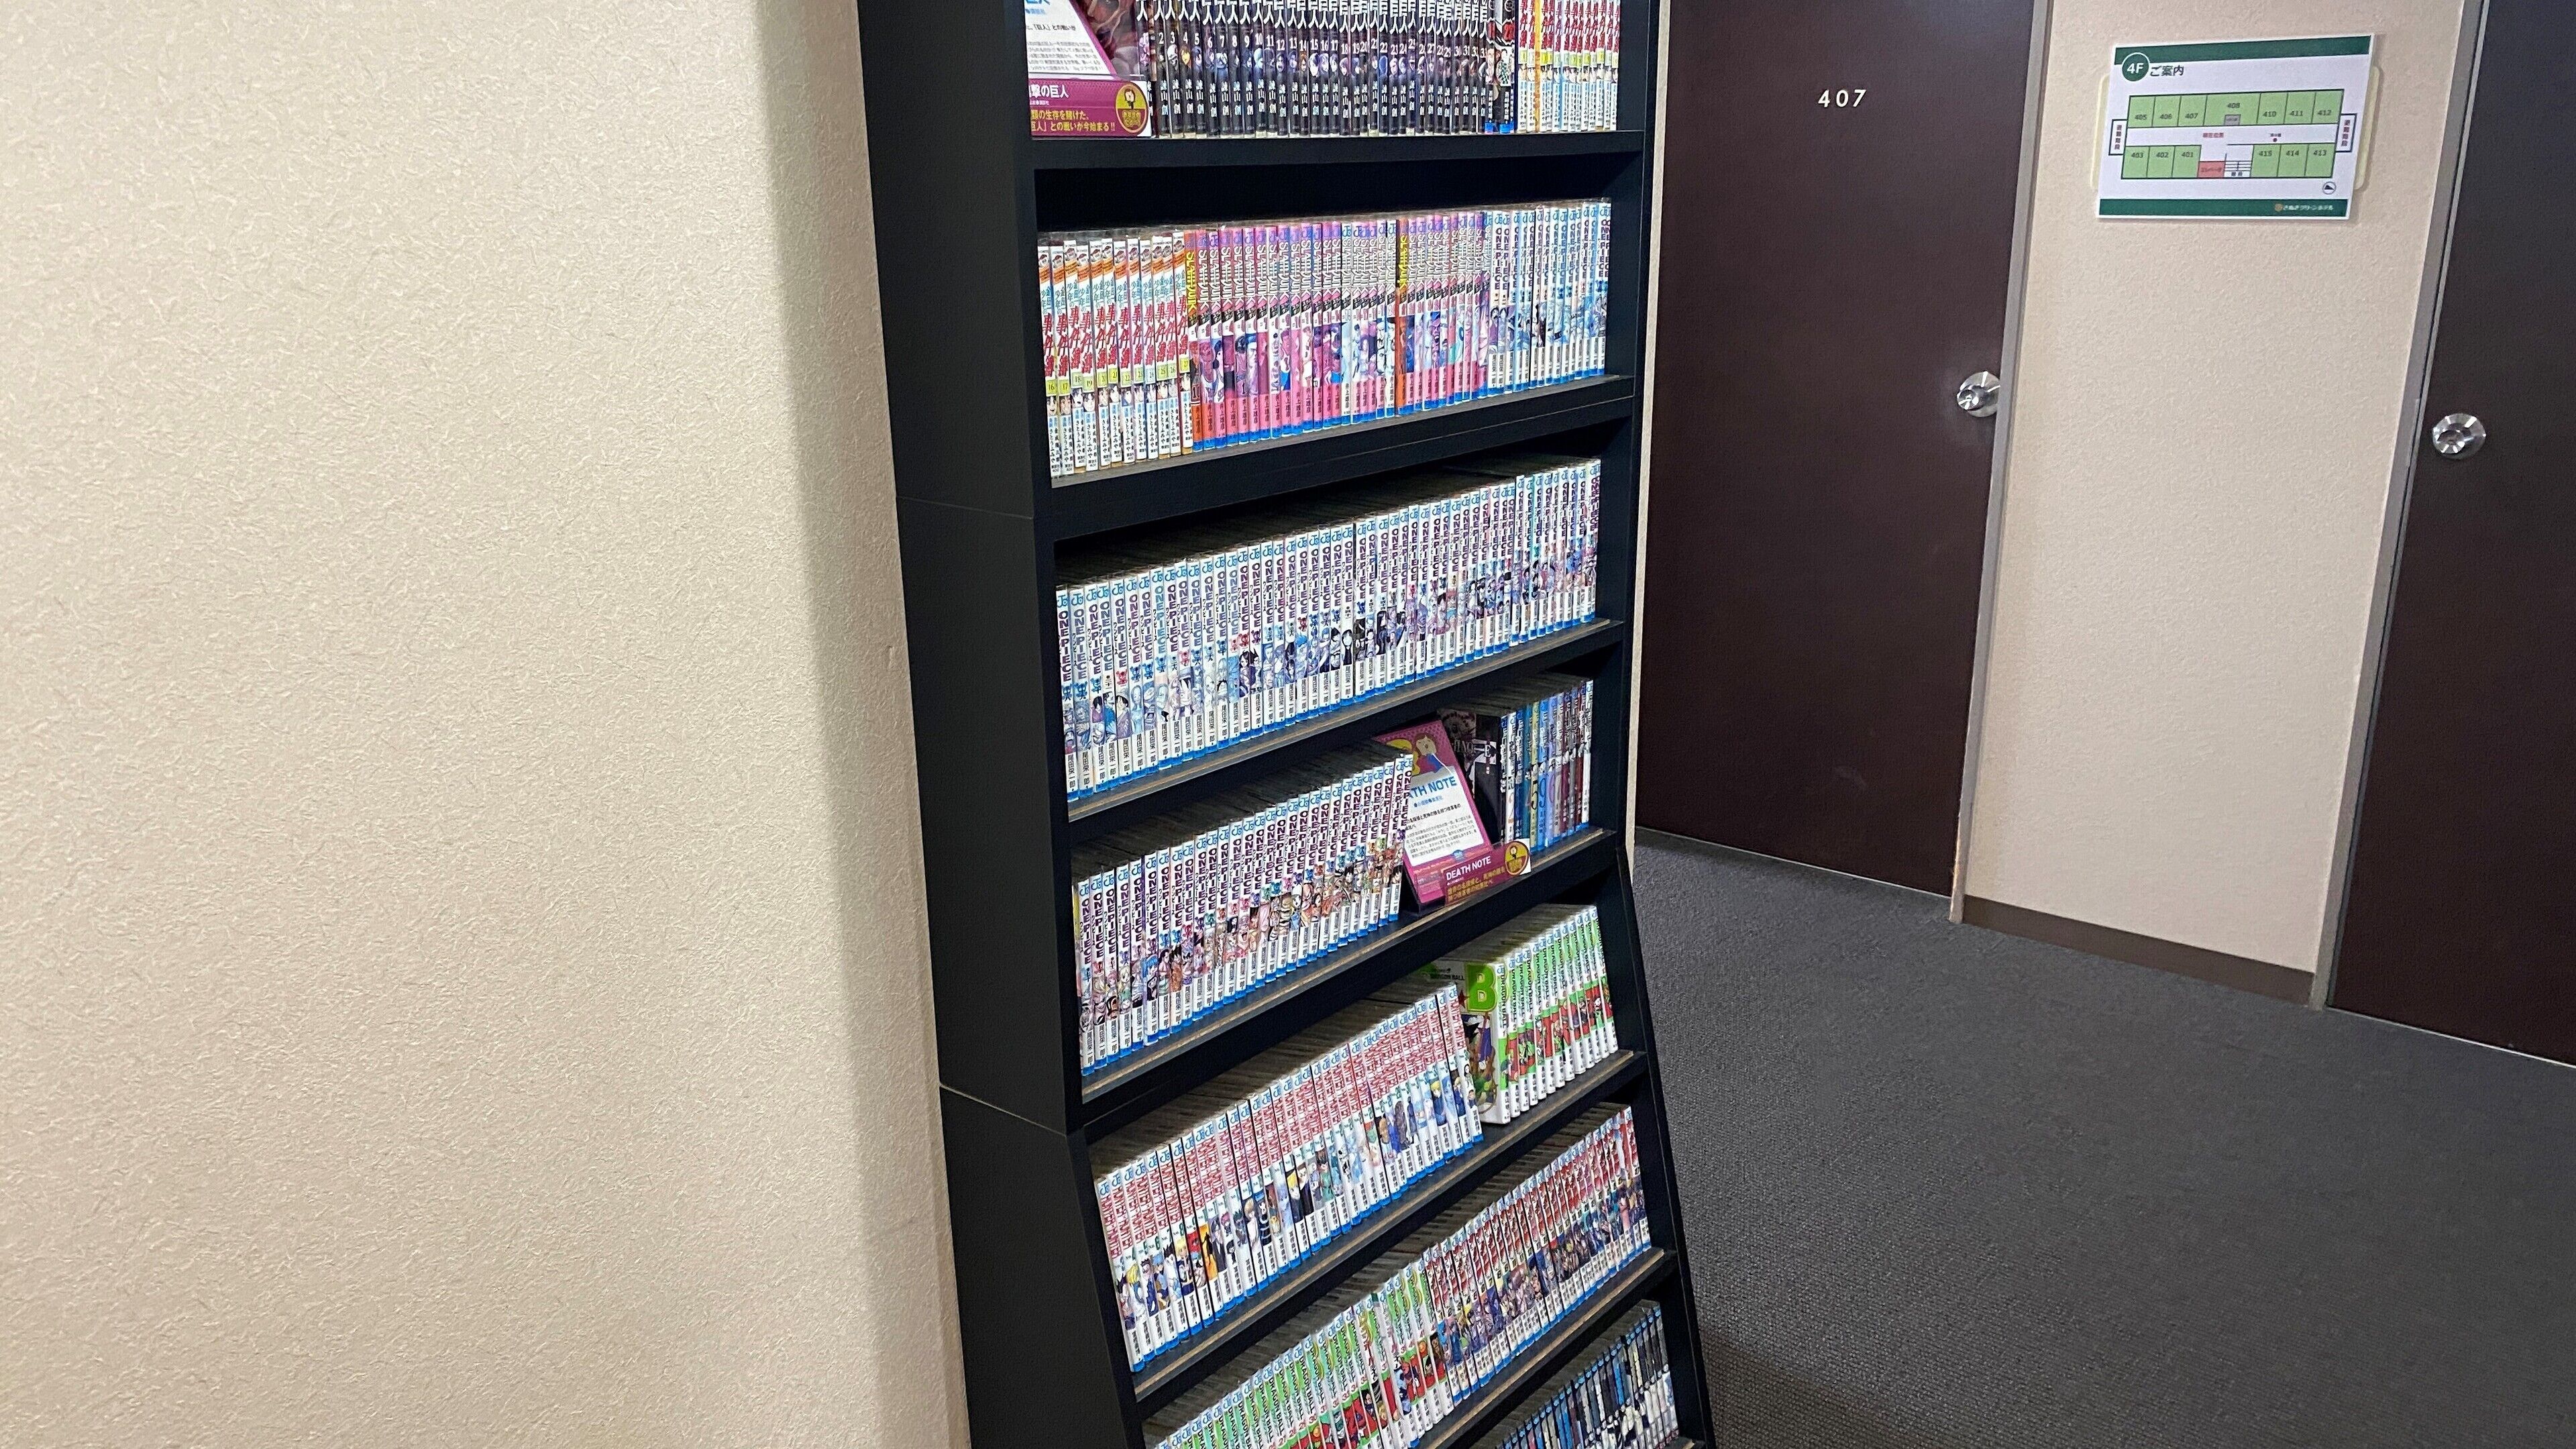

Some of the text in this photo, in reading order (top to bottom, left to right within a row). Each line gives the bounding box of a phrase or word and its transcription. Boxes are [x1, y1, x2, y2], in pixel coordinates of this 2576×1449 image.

[1159, 32, 1164, 44] 2
[1170, 32, 1175, 44] 3
[1183, 32, 1188, 44] 4
[1194, 33, 1199, 45] 5
[1208, 37, 1213, 48] 6
[1220, 36, 1225, 48] 7
[1232, 35, 1238, 48] 8
[1244, 36, 1250, 48] 9
[1254, 33, 1263, 45] 10
[1267, 34, 1274, 47] 11
[1276, 39, 1285, 51] 12
[1289, 37, 1297, 49] 13
[1299, 40, 1307, 51] 14
[1310, 38, 1318, 50] 15
[1320, 40, 1328, 51] 16
[1330, 40, 1338, 51] 17
[1341, 43, 1348, 55] 18
[2127, 62, 2144, 74] 4F
[2149, 64, 2184, 76] ご案内
[1028, 84, 1069, 99] 撃の巨人
[1818, 89, 1866, 107] 407
[1253, 588, 1261, 627] PIECE
[1167, 584, 1178, 652] ONE PIECE
[1099, 601, 1113, 671] ONE PIECE
[1115, 598, 1127, 667] ONE PIECE
[1129, 594, 1140, 663] ONE PIECE
[1059, 610, 1071, 682] ONE PIECE
[1073, 608, 1087, 680] ONE PIECE
[1089, 604, 1101, 674] ONE PIECE
[1428, 776, 1457, 793] NOTE
[1297, 810, 1308, 870] ONE PIECE
[1446, 865, 1471, 881] DEATH
[1472, 855, 1492, 871] NOTE
[1208, 848, 1217, 910] ONE PIECE
[1106, 888, 1116, 954] ONE PIECE
[1120, 883, 1130, 948] ONE PIECE
[1081, 899, 1091, 965] ONE PIECE
[1093, 892, 1104, 958] ONE PIECE
[1299, 1356, 1315, 1413] DRAGON BALL
[1269, 1377, 1285, 1436] DRAGON BALL
